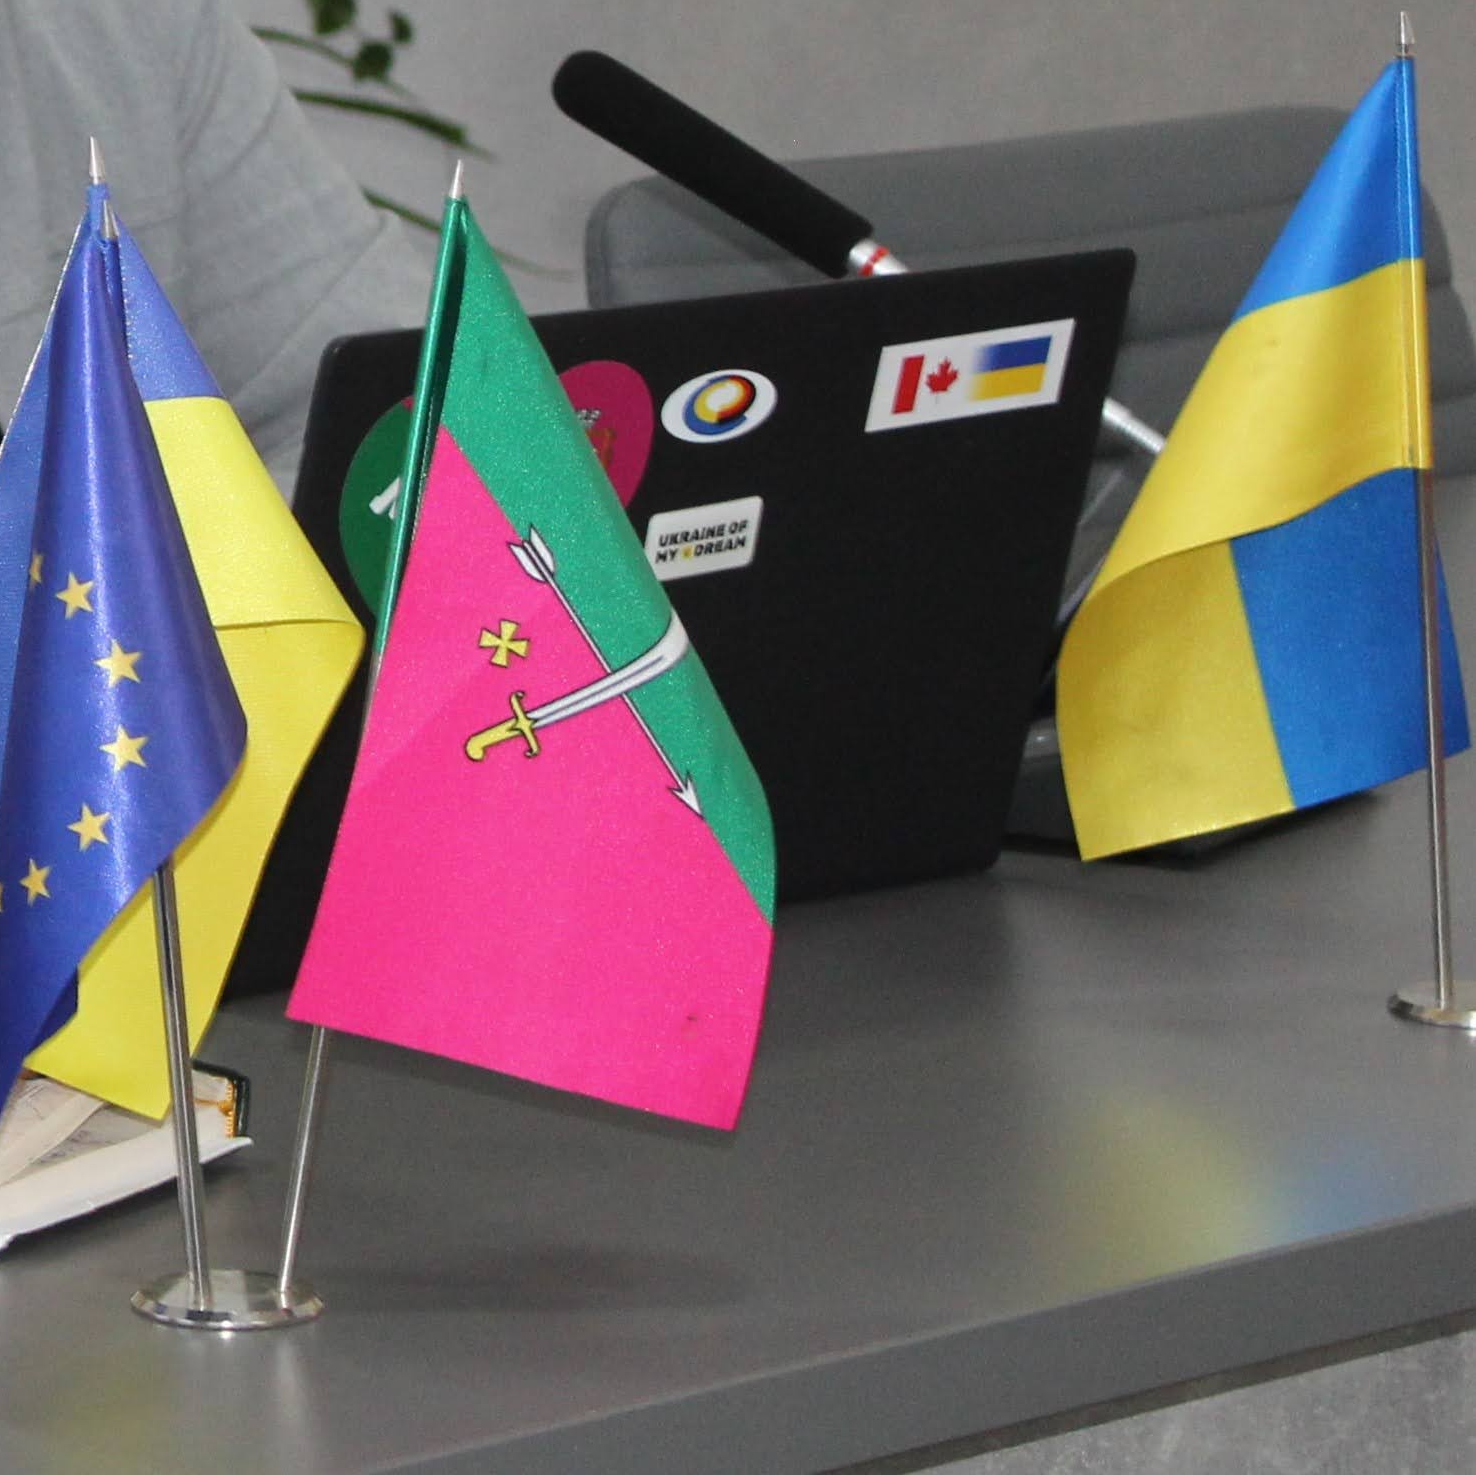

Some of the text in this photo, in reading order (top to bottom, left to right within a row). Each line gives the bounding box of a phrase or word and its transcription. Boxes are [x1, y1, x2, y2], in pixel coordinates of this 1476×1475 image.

[658, 520, 748, 547] UKRAINE OF
[655, 536, 746, 564] MY DREAM
